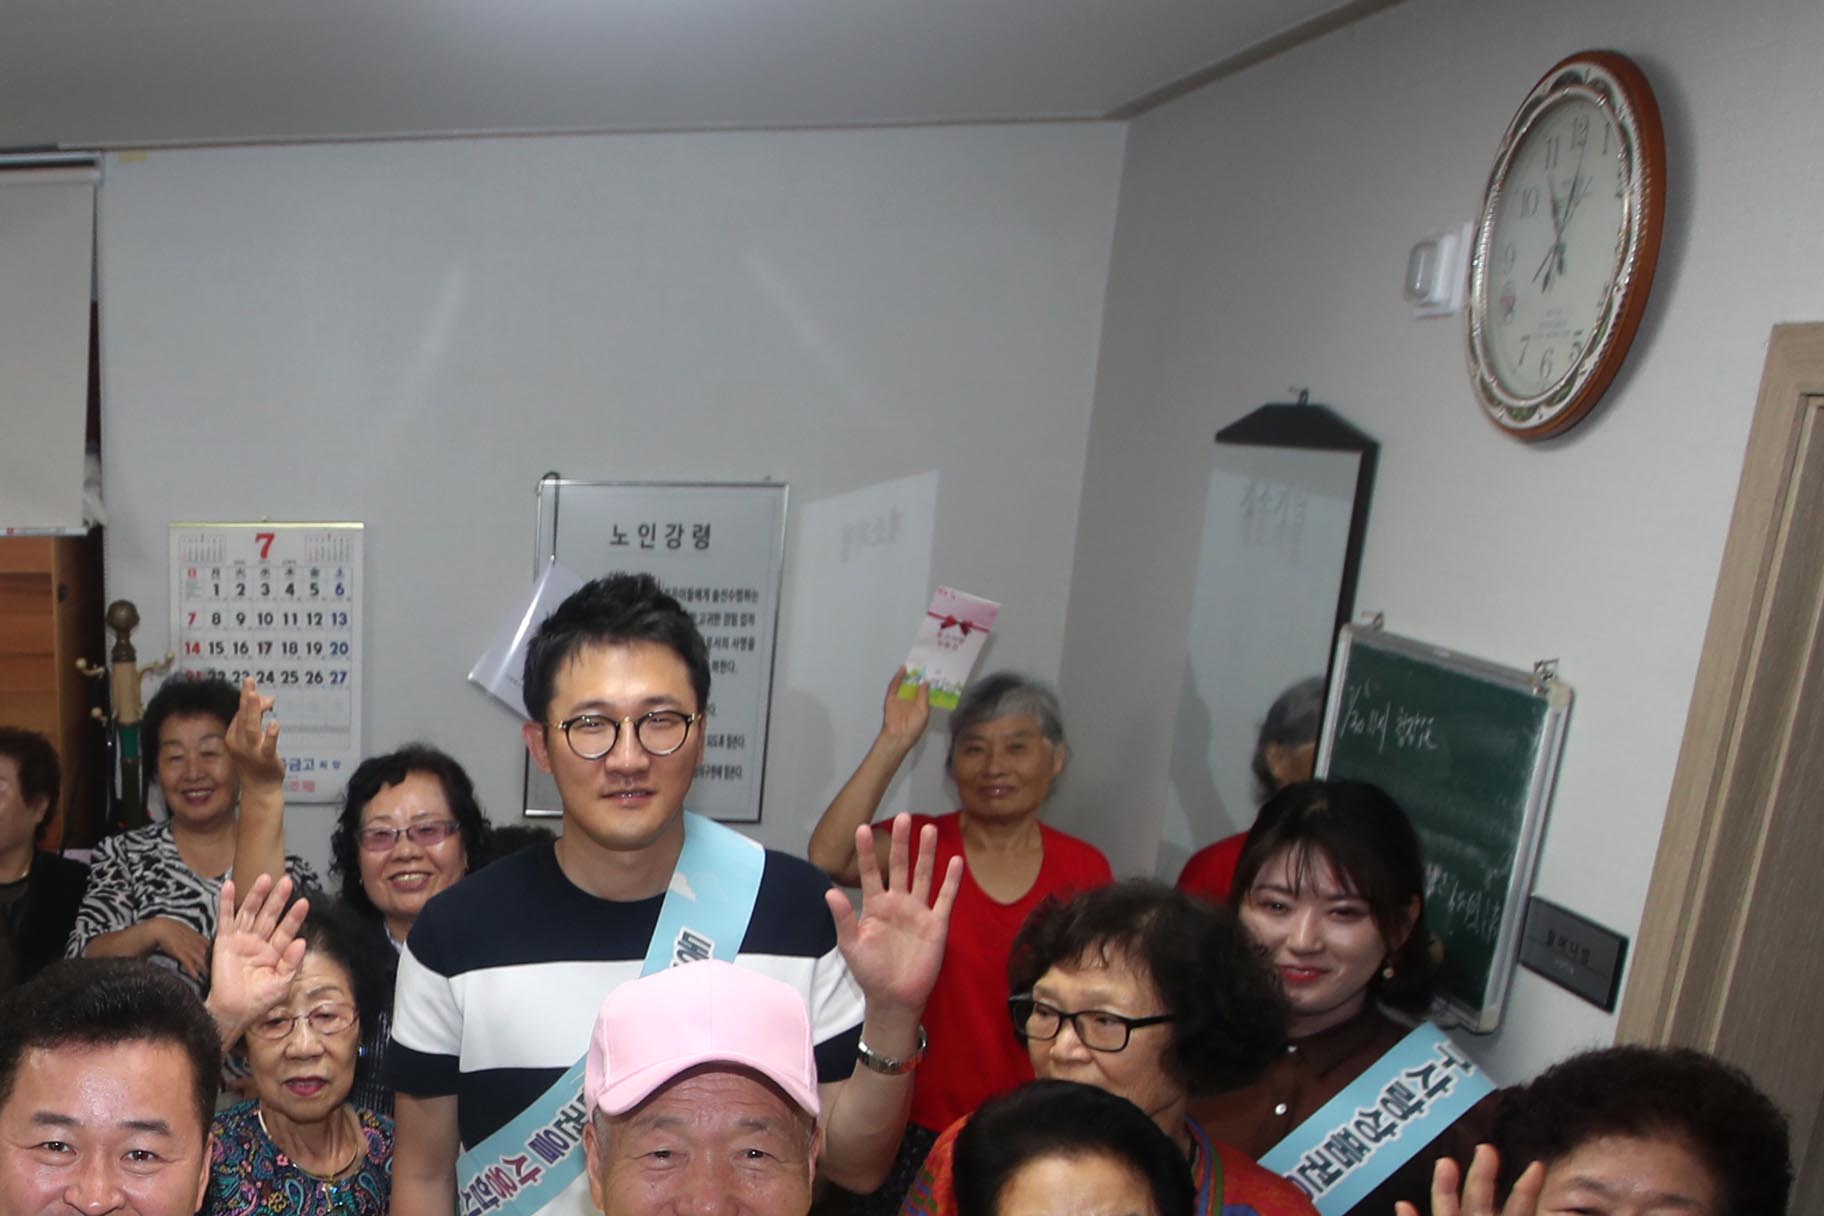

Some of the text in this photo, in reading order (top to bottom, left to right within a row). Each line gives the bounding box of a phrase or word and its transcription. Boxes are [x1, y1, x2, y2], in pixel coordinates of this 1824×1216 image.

[255, 533, 275, 560] 7
[213, 583, 344, 596] 1 2 3 4 5 6
[187, 612, 348, 625] 7 8 9 10 11 12 13
[184, 641, 348, 654] 14 15 16 17 18 19 20
[256, 670, 275, 684] 24
[280, 670, 299, 684] 25
[305, 670, 323, 684] 26
[329, 670, 348, 684] 27
[1287, 1044, 1473, 1198] 사랑상품권
